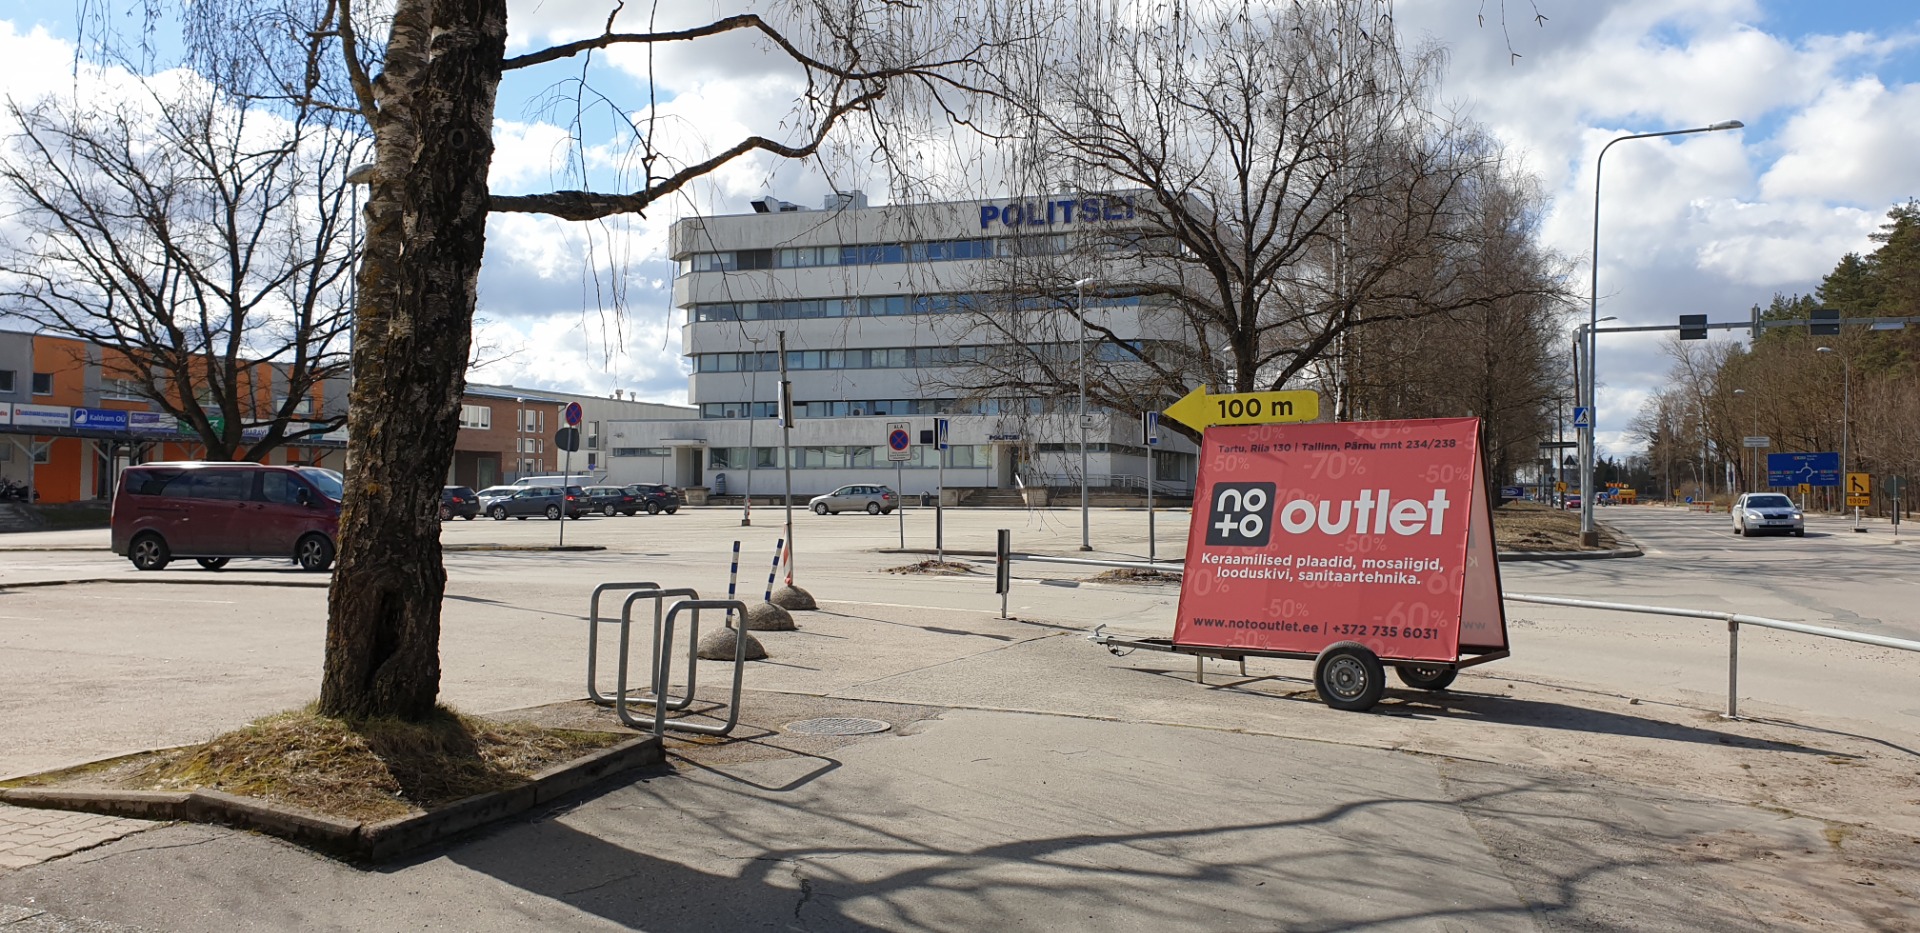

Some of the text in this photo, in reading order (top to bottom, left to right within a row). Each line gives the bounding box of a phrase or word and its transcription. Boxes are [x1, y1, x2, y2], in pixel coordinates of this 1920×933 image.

[980, 196, 1135, 228] POLITSEI
[1218, 398, 1293, 418] 100 m
[1219, 445, 1248, 454] Tartu,
[1250, 444, 1270, 453] Riia
[1273, 443, 1291, 452] 130
[1301, 442, 1341, 452] Tallinn,
[1344, 441, 1376, 451] Pärnu
[1379, 441, 1402, 450] mnt
[1405, 438, 1457, 450] 234/238
[1303, 452, 1367, 480] -70%
[1418, 464, 1470, 484] -50%
[1280, 488, 1451, 536] outlet
[1201, 552, 1445, 573] Keraamilised plaadid, mosaiigid,
[1216, 566, 1294, 582] looduskivi,
[1297, 570, 1422, 585] sanitaartehnika.
[1261, 599, 1310, 619] -50%
[1193, 617, 1319, 633] www.notooutlet.ee
[1332, 623, 1367, 637] +372
[1372, 625, 1398, 638] 735
[1402, 627, 1439, 640] 6031
